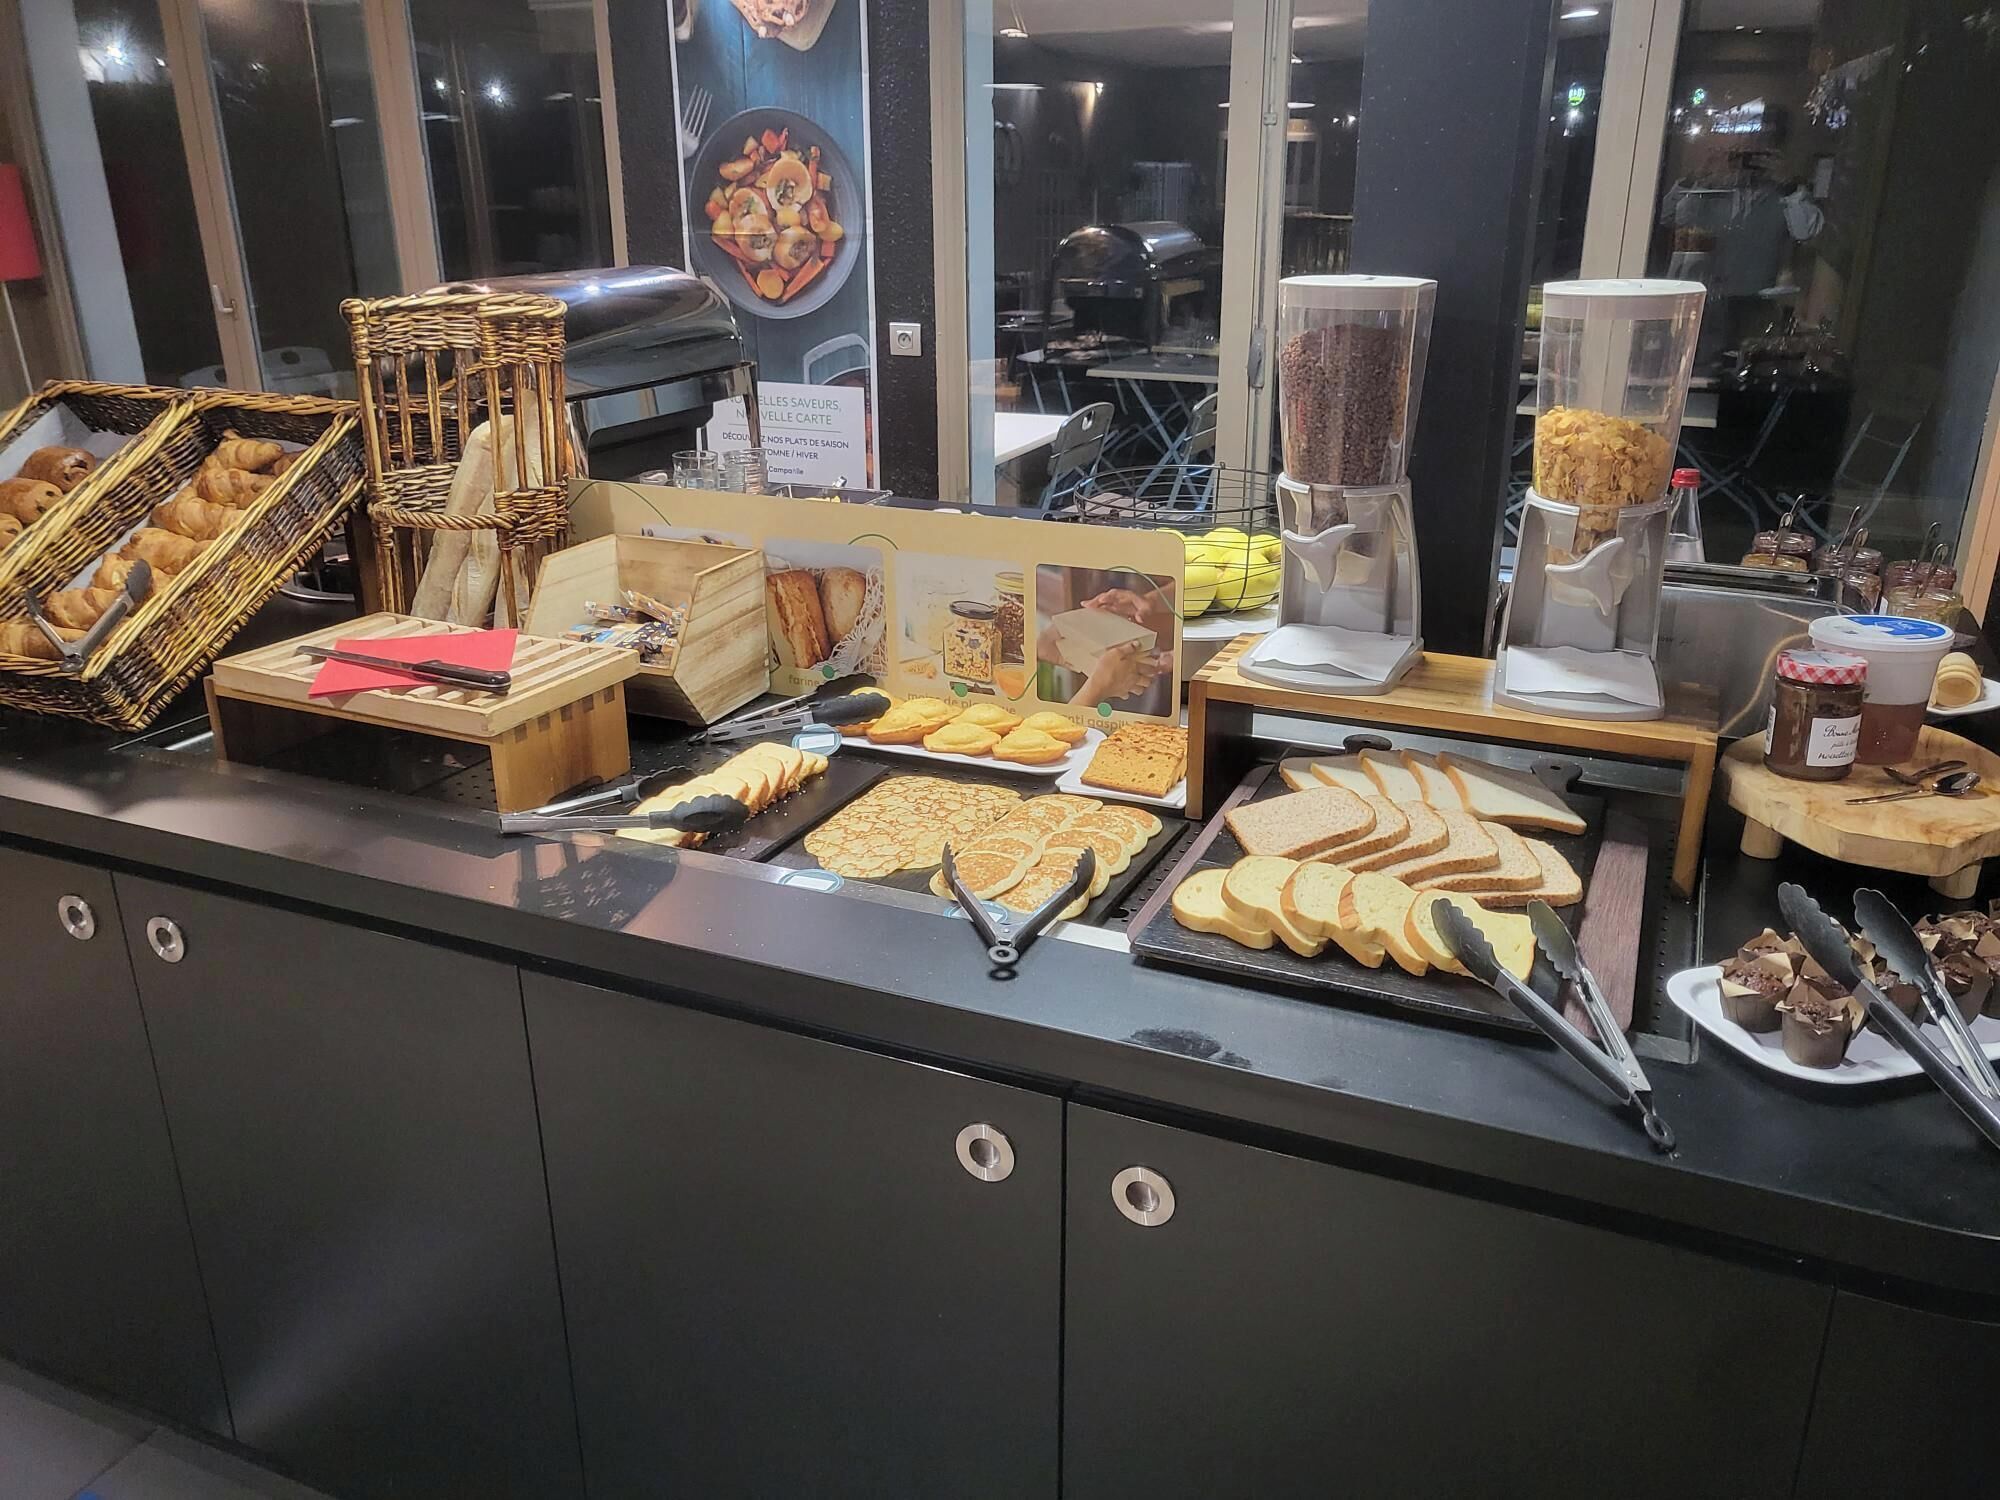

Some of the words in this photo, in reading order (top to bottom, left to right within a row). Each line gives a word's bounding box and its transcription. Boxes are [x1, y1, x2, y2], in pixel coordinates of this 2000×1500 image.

[791, 398, 842, 412] SAVEURS,
[736, 409, 793, 423] NVELLE
[796, 413, 832, 425] CARTE
[767, 436, 784, 444] NOS
[785, 437, 808, 446] PLATS
[809, 439, 821, 447] DE
[820, 440, 849, 449] SAISON
[767, 449, 791, 458] OMNE
[796, 451, 818, 460] HIVER
